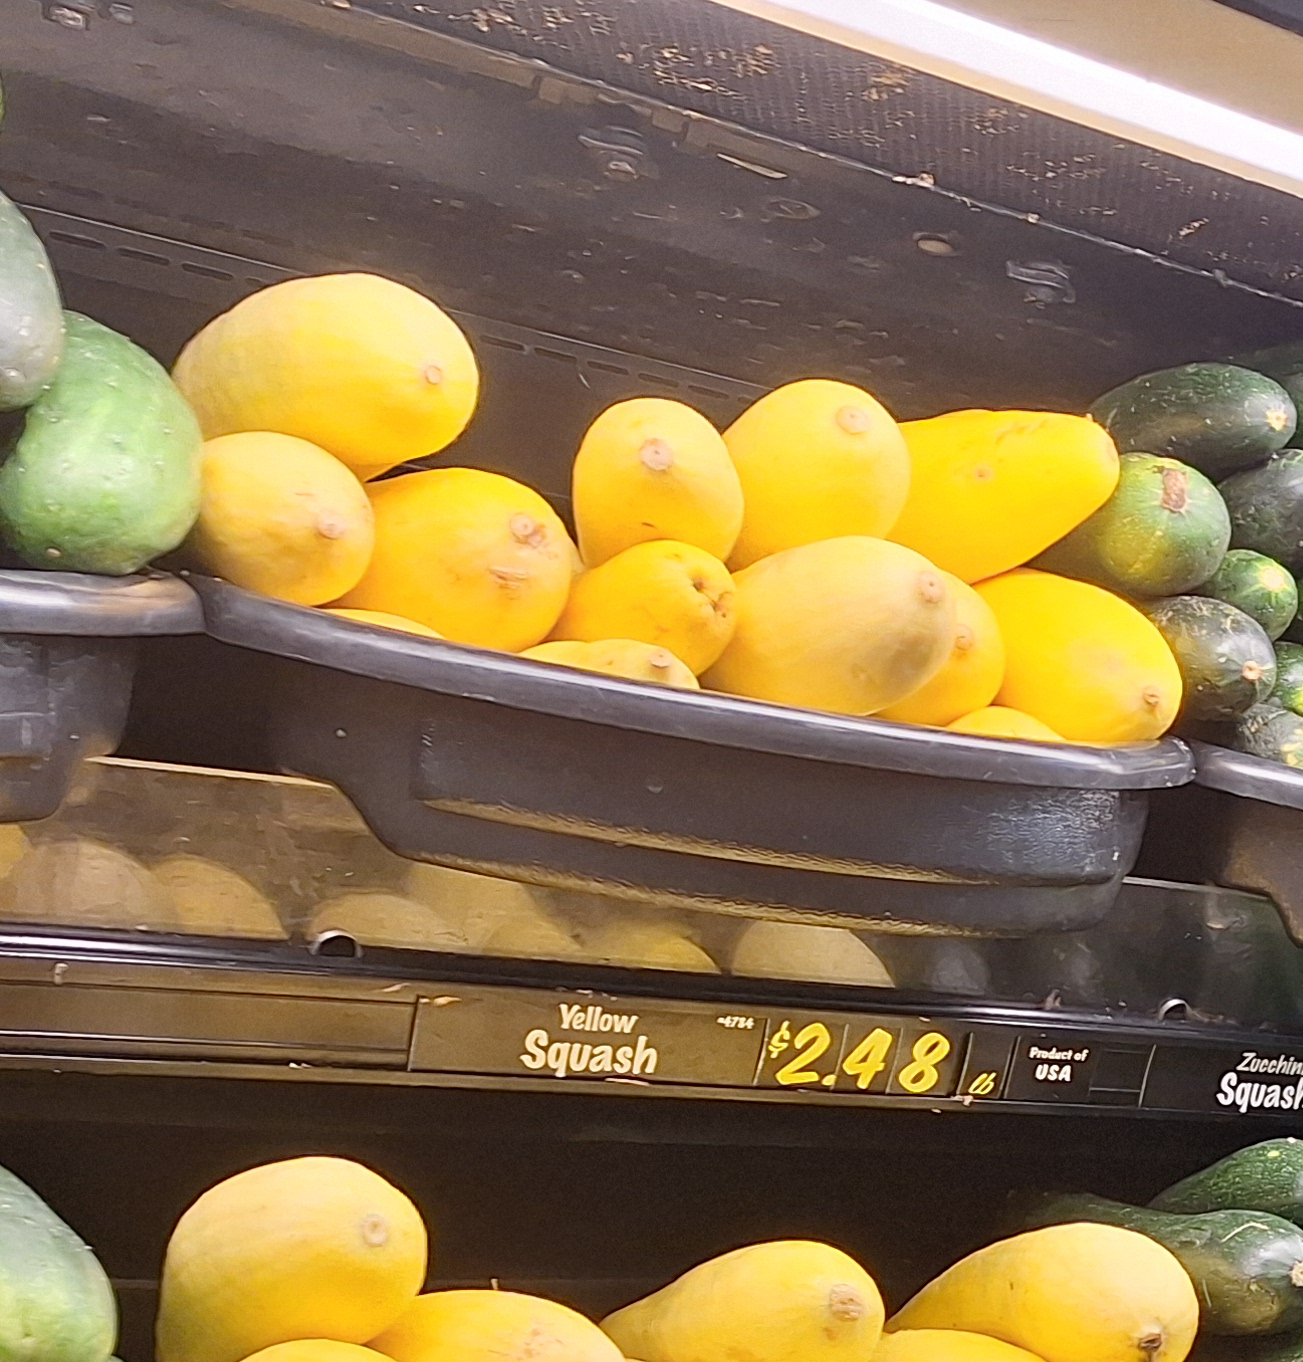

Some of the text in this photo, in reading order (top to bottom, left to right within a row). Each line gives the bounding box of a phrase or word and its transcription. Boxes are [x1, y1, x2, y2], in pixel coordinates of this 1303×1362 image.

[559, 1003, 639, 1033] Yellow
[519, 1029, 658, 1078] Squash
[768, 1020, 951, 1093] $2.48
[1029, 1046, 1089, 1061] Product of
[1035, 1063, 1071, 1082] USA
